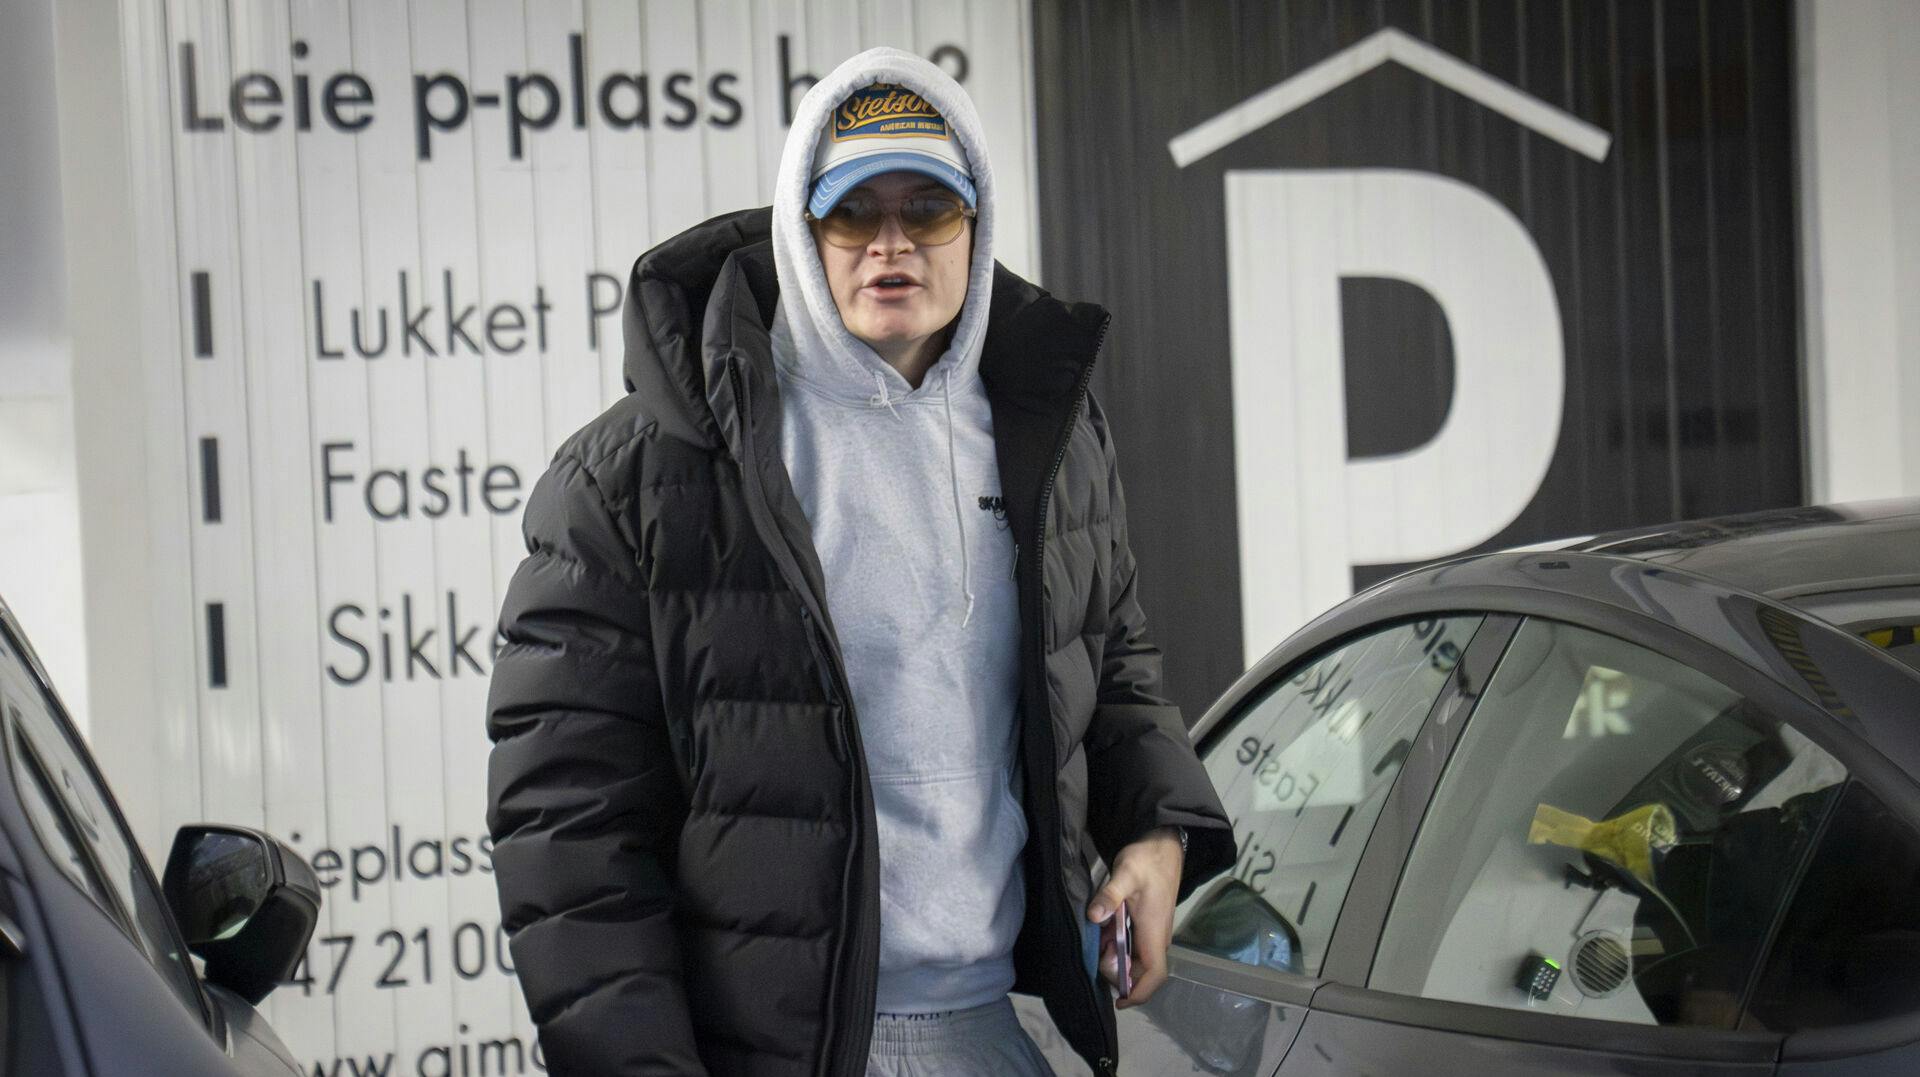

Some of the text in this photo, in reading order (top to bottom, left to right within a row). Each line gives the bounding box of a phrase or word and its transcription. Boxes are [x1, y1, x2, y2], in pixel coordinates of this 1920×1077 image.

[180, 41, 374, 133] Leie
[415, 33, 743, 161] p-plass
[313, 269, 553, 360] Lukket
[1224, 167, 1566, 673] P
[320, 441, 522, 525] Faste
[290, 825, 494, 902] eplass
[375, 927, 434, 988] 21
